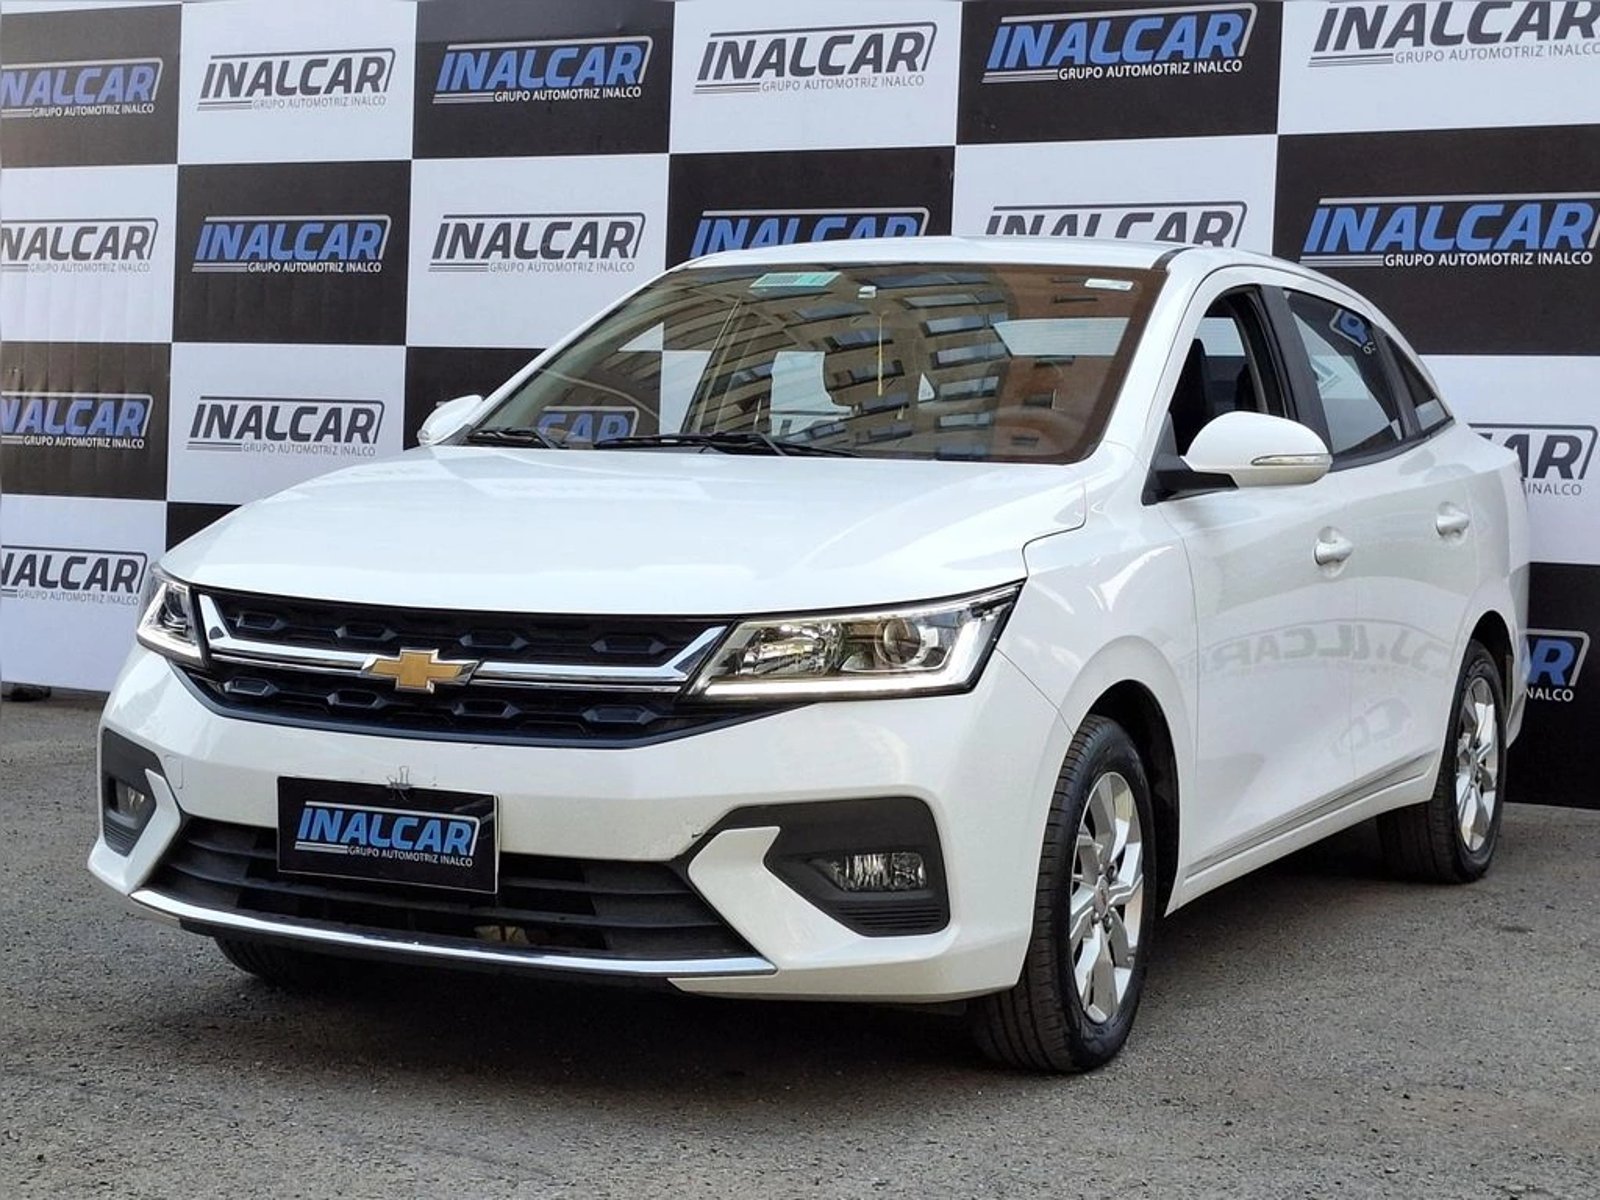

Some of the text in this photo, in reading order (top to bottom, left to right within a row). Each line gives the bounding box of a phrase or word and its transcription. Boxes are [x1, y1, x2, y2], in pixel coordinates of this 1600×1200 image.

[1313, 1, 1600, 52] INALCAR
[987, 13, 1245, 69] INALCAR
[697, 32, 925, 80] INALCAR
[1395, 50, 1445, 64] GRUPO
[1449, 45, 1544, 61] AUTOMOTRIZ
[200, 57, 386, 98] INALCAR
[436, 45, 642, 90] INALCAR
[1058, 59, 1243, 80] GRUPO AUTOMOTRIZ INALCO
[761, 75, 925, 92] GRUPO AUTOMOTRIZ INALCO
[252, 95, 387, 110] GRUPO AUTOMOTRIZ INALCO
[494, 87, 642, 103] GRUPO AUTOMOTRIZ INALCO
[32, 103, 155, 118] GRUPO AUTOMOTRIZ INALCO
[1303, 202, 1594, 252] INALCAR
[195, 223, 382, 261] INALCAR
[432, 222, 635, 260] INALCAR
[247, 262, 382, 273] GRUPO AUTOMOTRIZ INALCO
[489, 262, 635, 273] GRUPO AUTOMOTRIZ INALCO
[1384, 251, 1593, 267] GRUPO AUTOMOTRIZ INALCO
[189, 404, 376, 444] INALCAR
[24, 435, 145, 449] GRUPO AUTOMOTRIZ INALCO
[243, 443, 376, 457] GRUPO AUTOMOTRIZ INALCO
[1527, 483, 1582, 496] INALCO
[297, 808, 473, 856] INALCAR
[348, 846, 473, 867] GRUPO AUTOMOTRIZ INALCO
